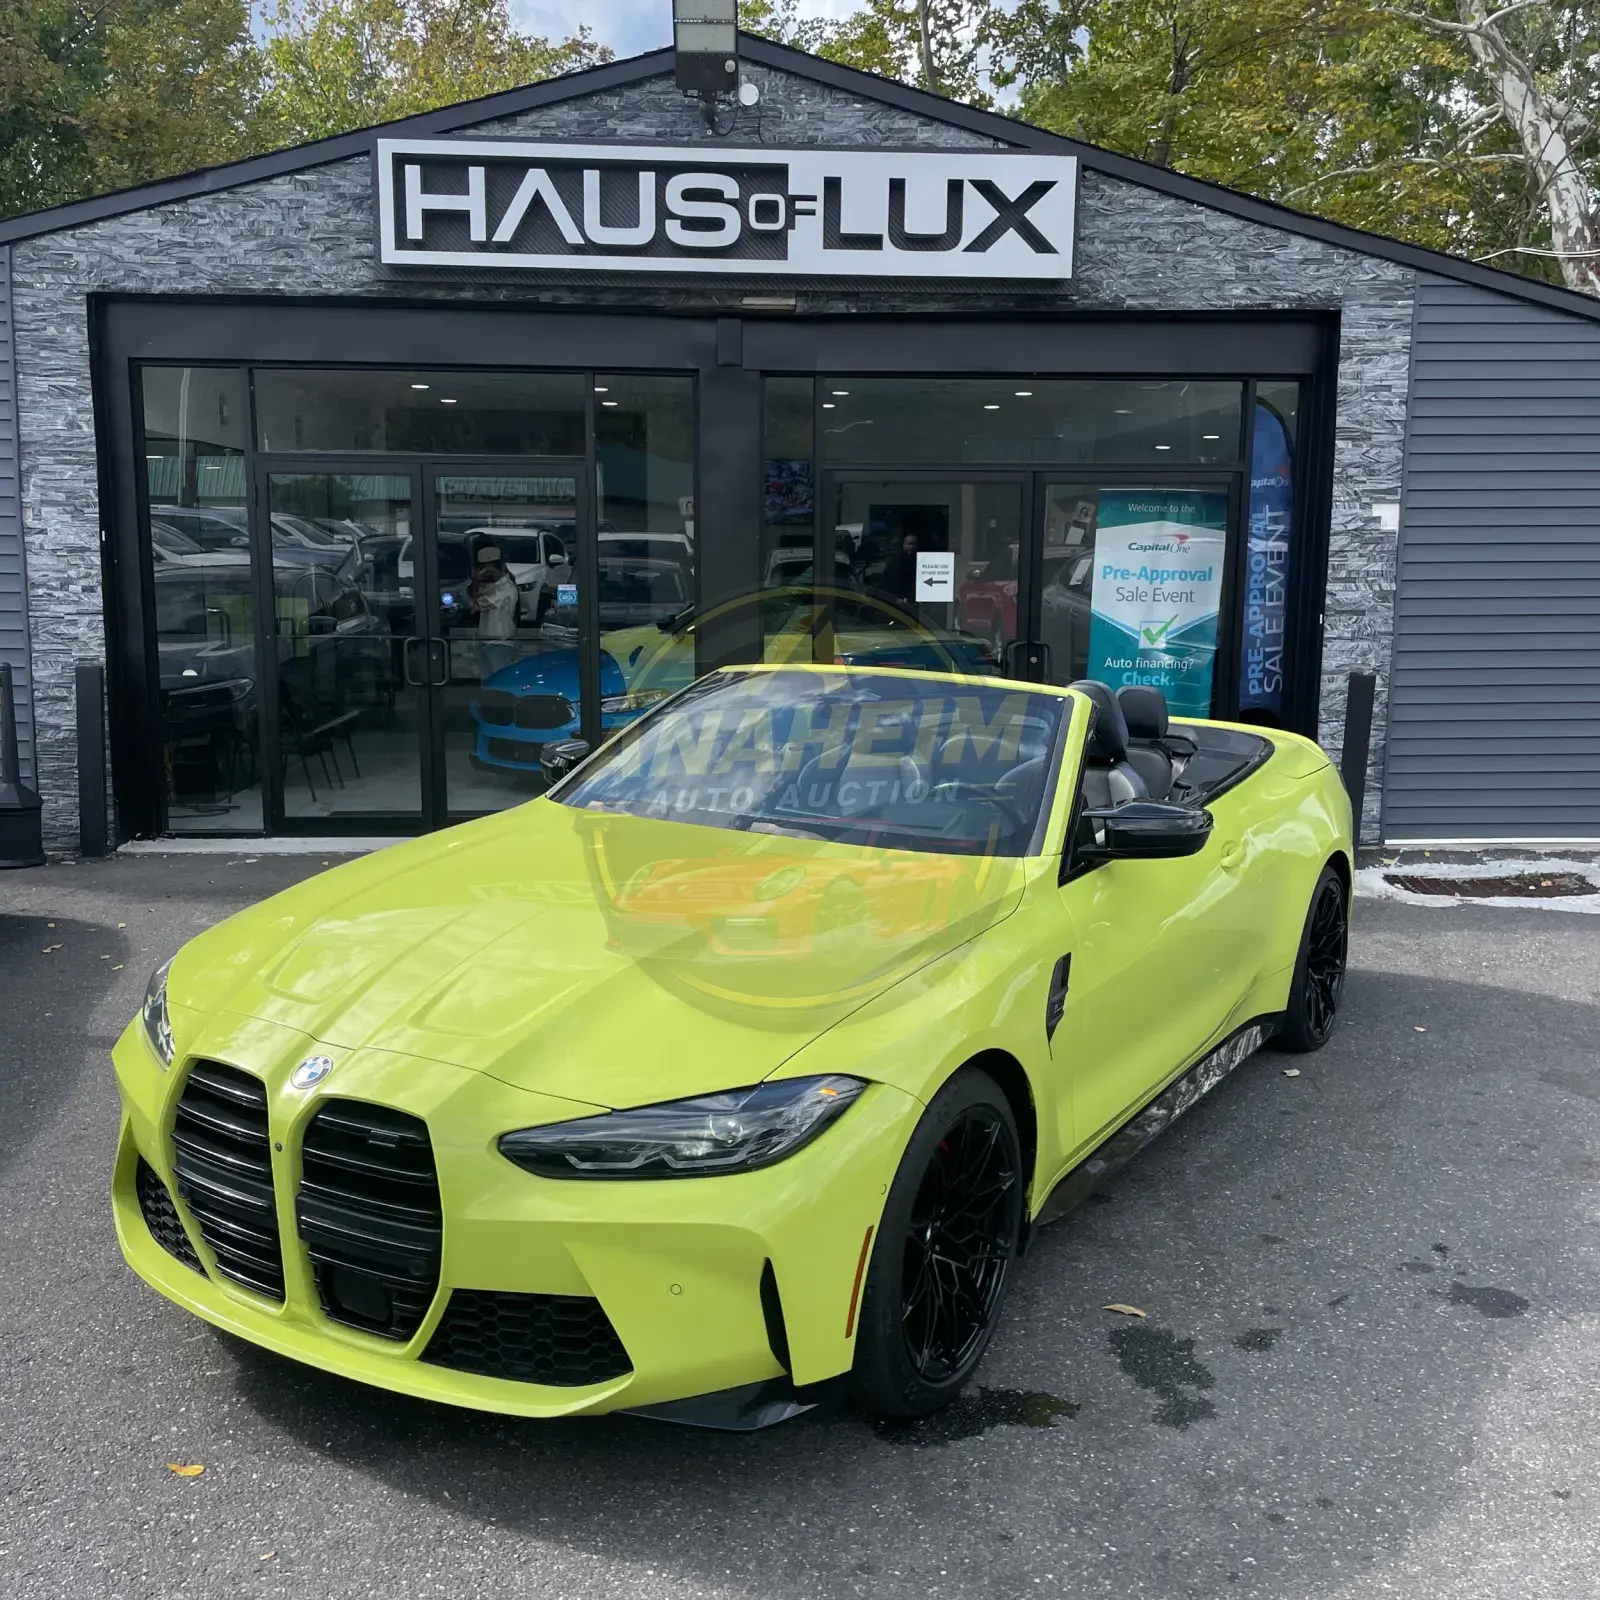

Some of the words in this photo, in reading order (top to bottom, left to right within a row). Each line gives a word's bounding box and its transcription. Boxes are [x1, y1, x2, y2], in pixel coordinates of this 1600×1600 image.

[404, 164, 741, 247] HAUS
[748, 191, 817, 231] OF
[822, 176, 1060, 255] LUX
[1128, 503, 1167, 513] Welcome
[1169, 504, 1179, 513] to
[1181, 503, 1195, 513] the
[1265, 505, 1286, 606] EVENT
[1102, 565, 1212, 584] Pre-Approval
[1116, 586, 1148, 602] Sale
[1153, 587, 1195, 603] Event
[1264, 614, 1285, 692] SALE
[1104, 657, 1132, 668] Auto
[1135, 657, 1194, 672] financing?
[1122, 672, 1175, 686] Check.
